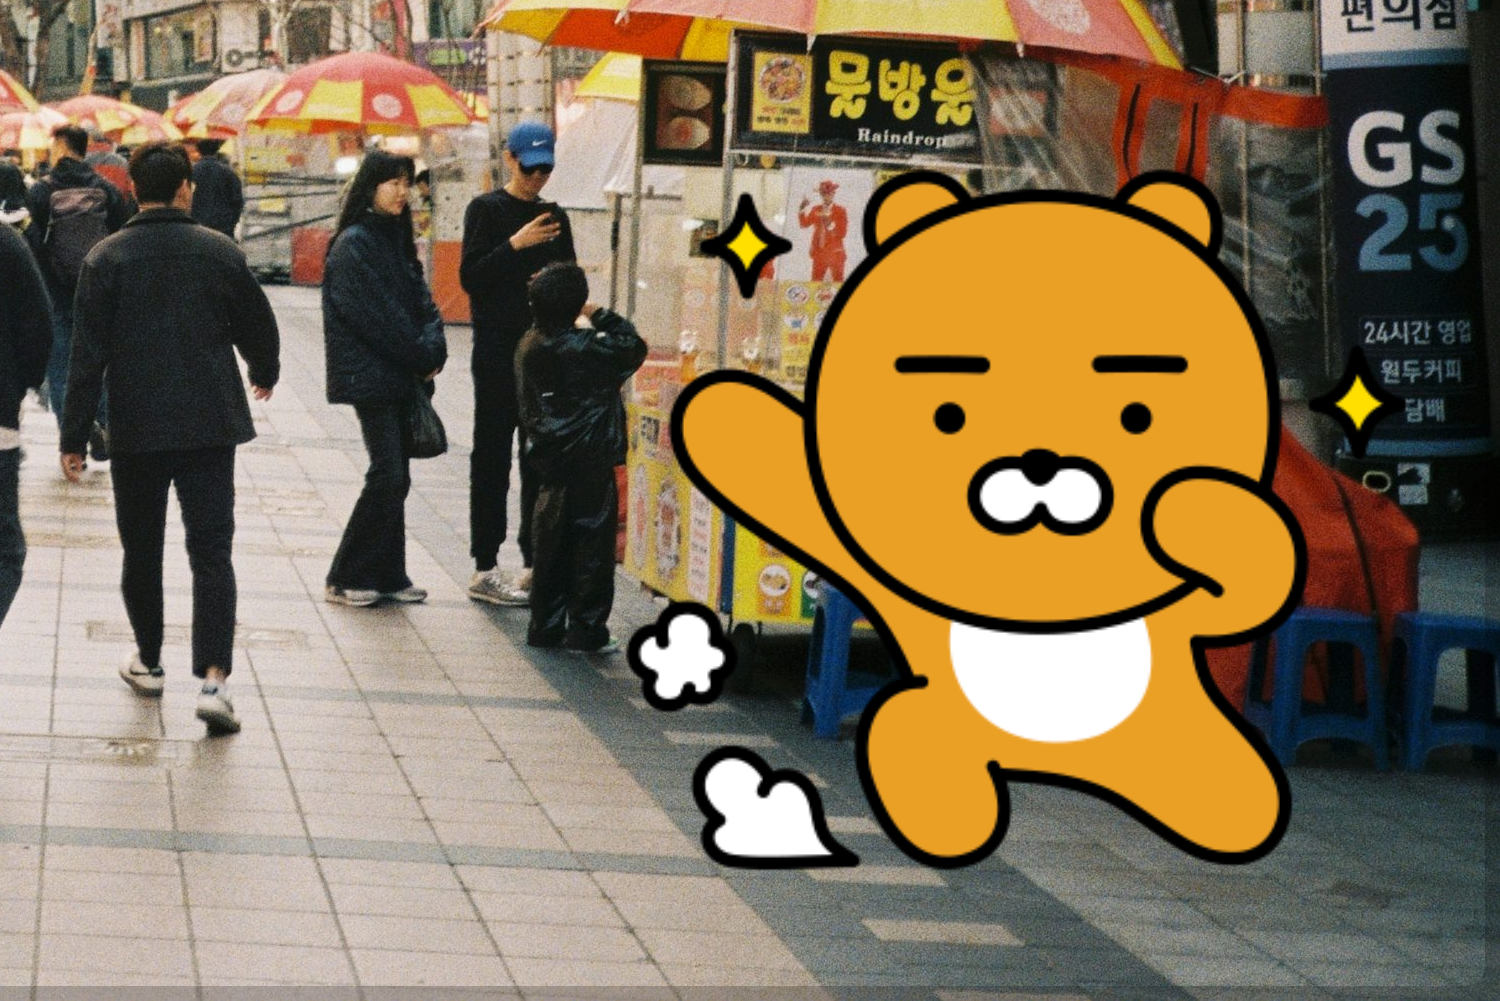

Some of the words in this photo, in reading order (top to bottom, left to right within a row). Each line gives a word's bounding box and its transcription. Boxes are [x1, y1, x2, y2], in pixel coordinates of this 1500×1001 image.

[857, 127, 949, 149] Raindrop
[1347, 109, 1466, 188] GS
[1355, 193, 1469, 272] 25
[1363, 320, 1432, 346] 24시간
[1437, 318, 1473, 345] 영업
[1380, 358, 1463, 385] 원두커피
[1405, 397, 1446, 424] 담배
